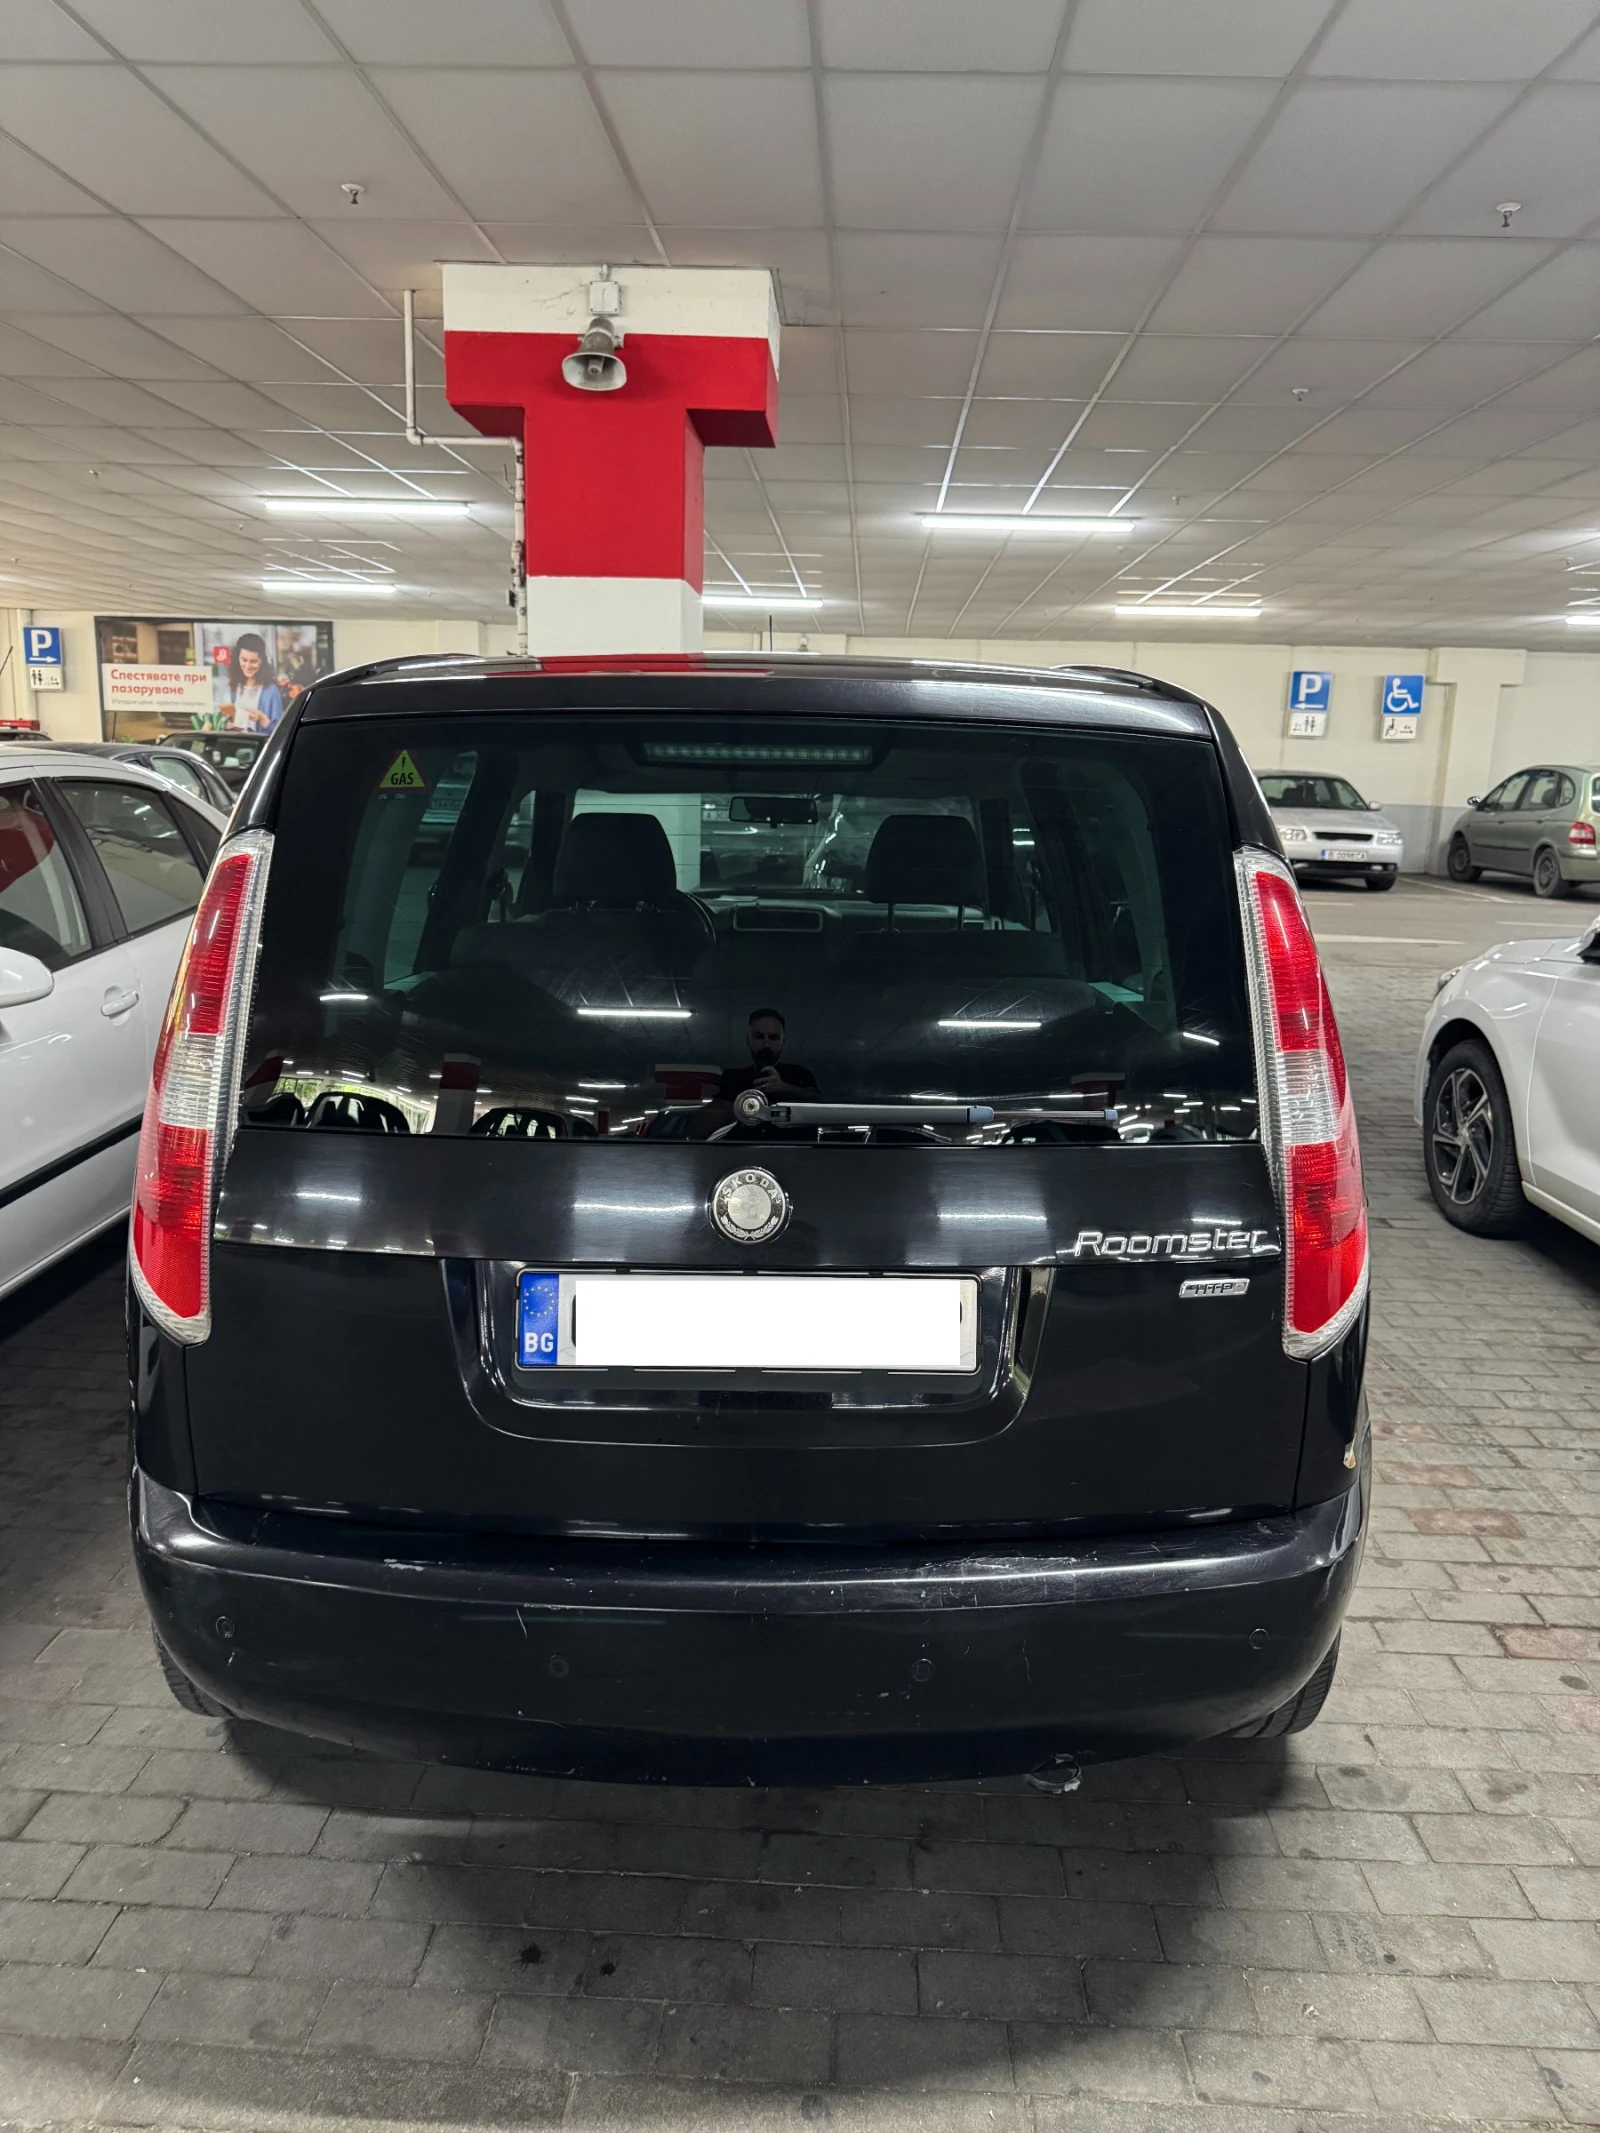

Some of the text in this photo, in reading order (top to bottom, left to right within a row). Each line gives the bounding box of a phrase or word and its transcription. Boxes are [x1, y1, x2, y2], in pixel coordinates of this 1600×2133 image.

[30, 629, 53, 657] P
[110, 669, 207, 684] Спестявате при
[111, 685, 184, 697] пазаруване
[1298, 673, 1322, 702] P
[390, 772, 414, 785] GAS
[1074, 1228, 1268, 1257] Roomster
[524, 1332, 554, 1353] BG
